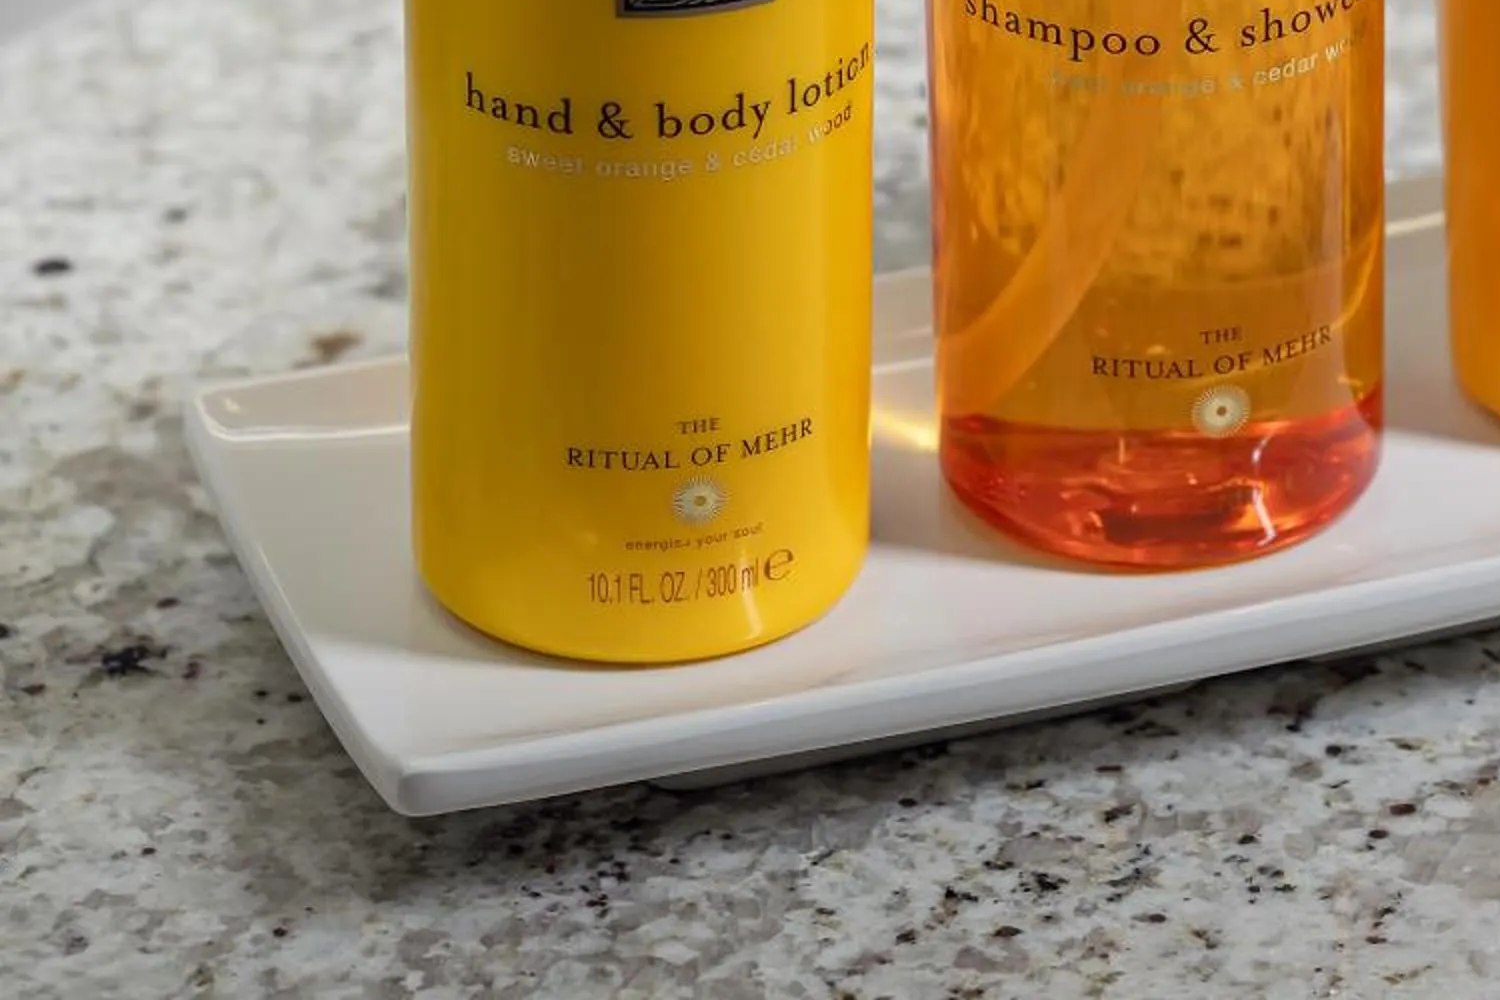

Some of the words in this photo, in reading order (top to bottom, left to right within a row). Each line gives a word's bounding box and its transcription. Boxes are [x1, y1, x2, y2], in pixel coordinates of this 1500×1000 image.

[1184, 18, 1220, 55] &
[1254, 53, 1319, 85] cedar
[464, 71, 573, 135] hand
[597, 101, 634, 139] &
[655, 93, 772, 140] body
[786, 41, 870, 115] lotion
[506, 146, 583, 174] sweet
[595, 158, 693, 182] orange
[704, 151, 720, 173] &
[1091, 355, 1204, 380] RITUAL
[1213, 351, 1253, 375] OF
[1262, 324, 1332, 367] MEHR
[1199, 326, 1243, 345] THE
[567, 446, 681, 471] RITUAL
[691, 443, 731, 466] OF
[740, 417, 814, 460] MEHR
[675, 417, 721, 435] THE
[696, 533, 728, 548] your
[588, 571, 622, 604] 10.1
[694, 567, 703, 600] /
[707, 564, 737, 598] 300
[741, 556, 759, 593] ml
